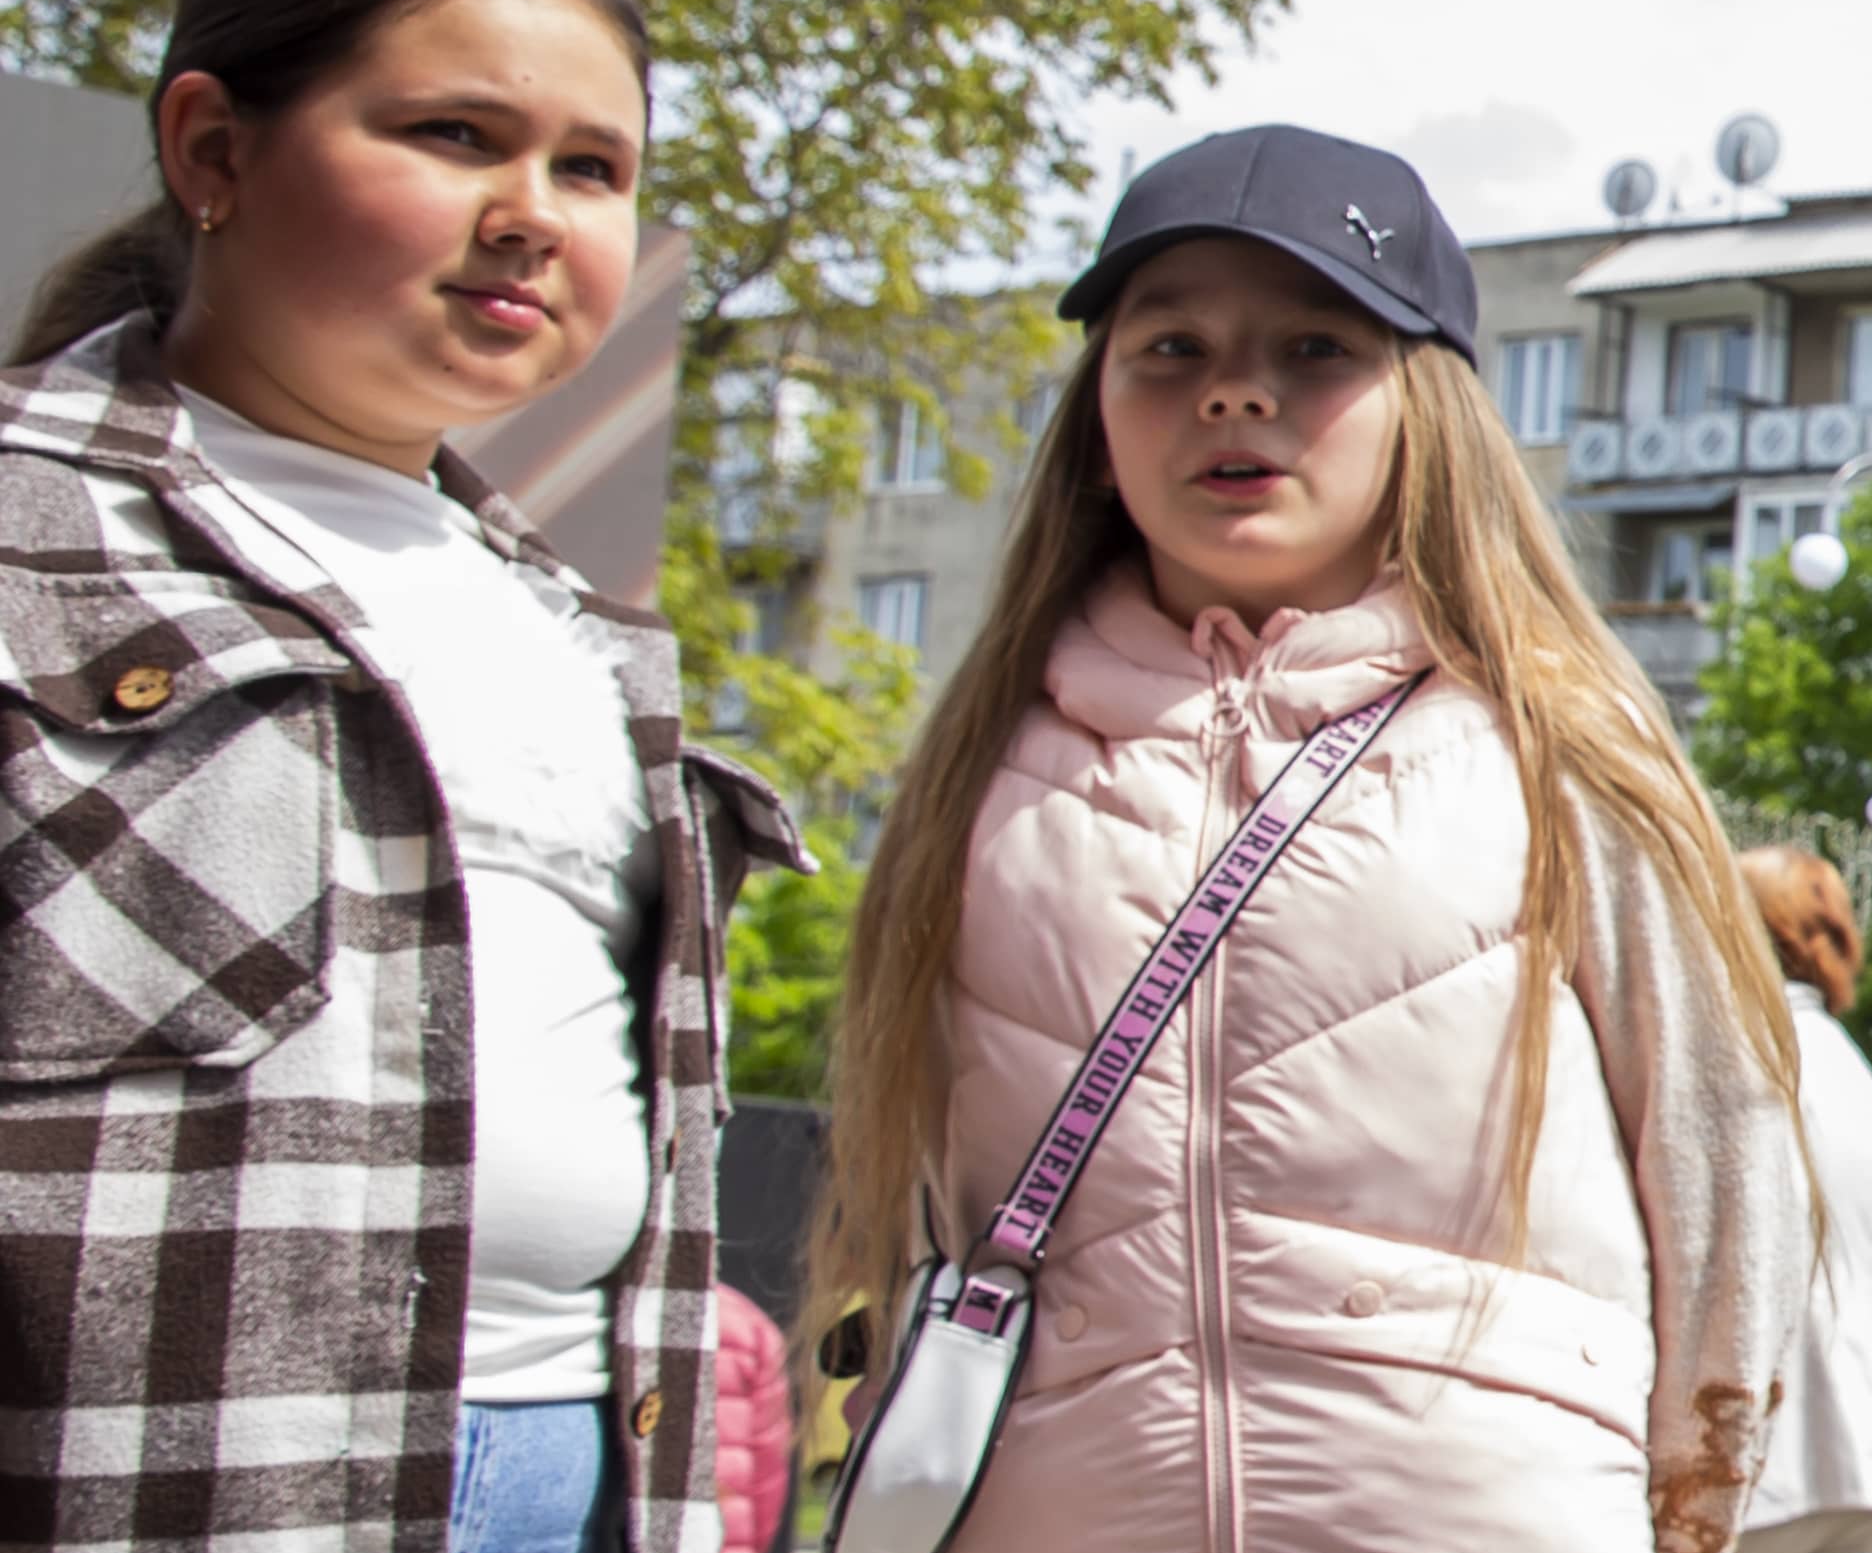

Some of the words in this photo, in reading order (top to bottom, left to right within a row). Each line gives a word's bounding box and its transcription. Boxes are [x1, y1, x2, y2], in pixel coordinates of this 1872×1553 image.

[1197, 813, 1288, 917] DREAM
[1127, 928, 1209, 1021] WITH
[1071, 1031, 1144, 1116] YOUR
[1006, 1127, 1086, 1239] HEART
